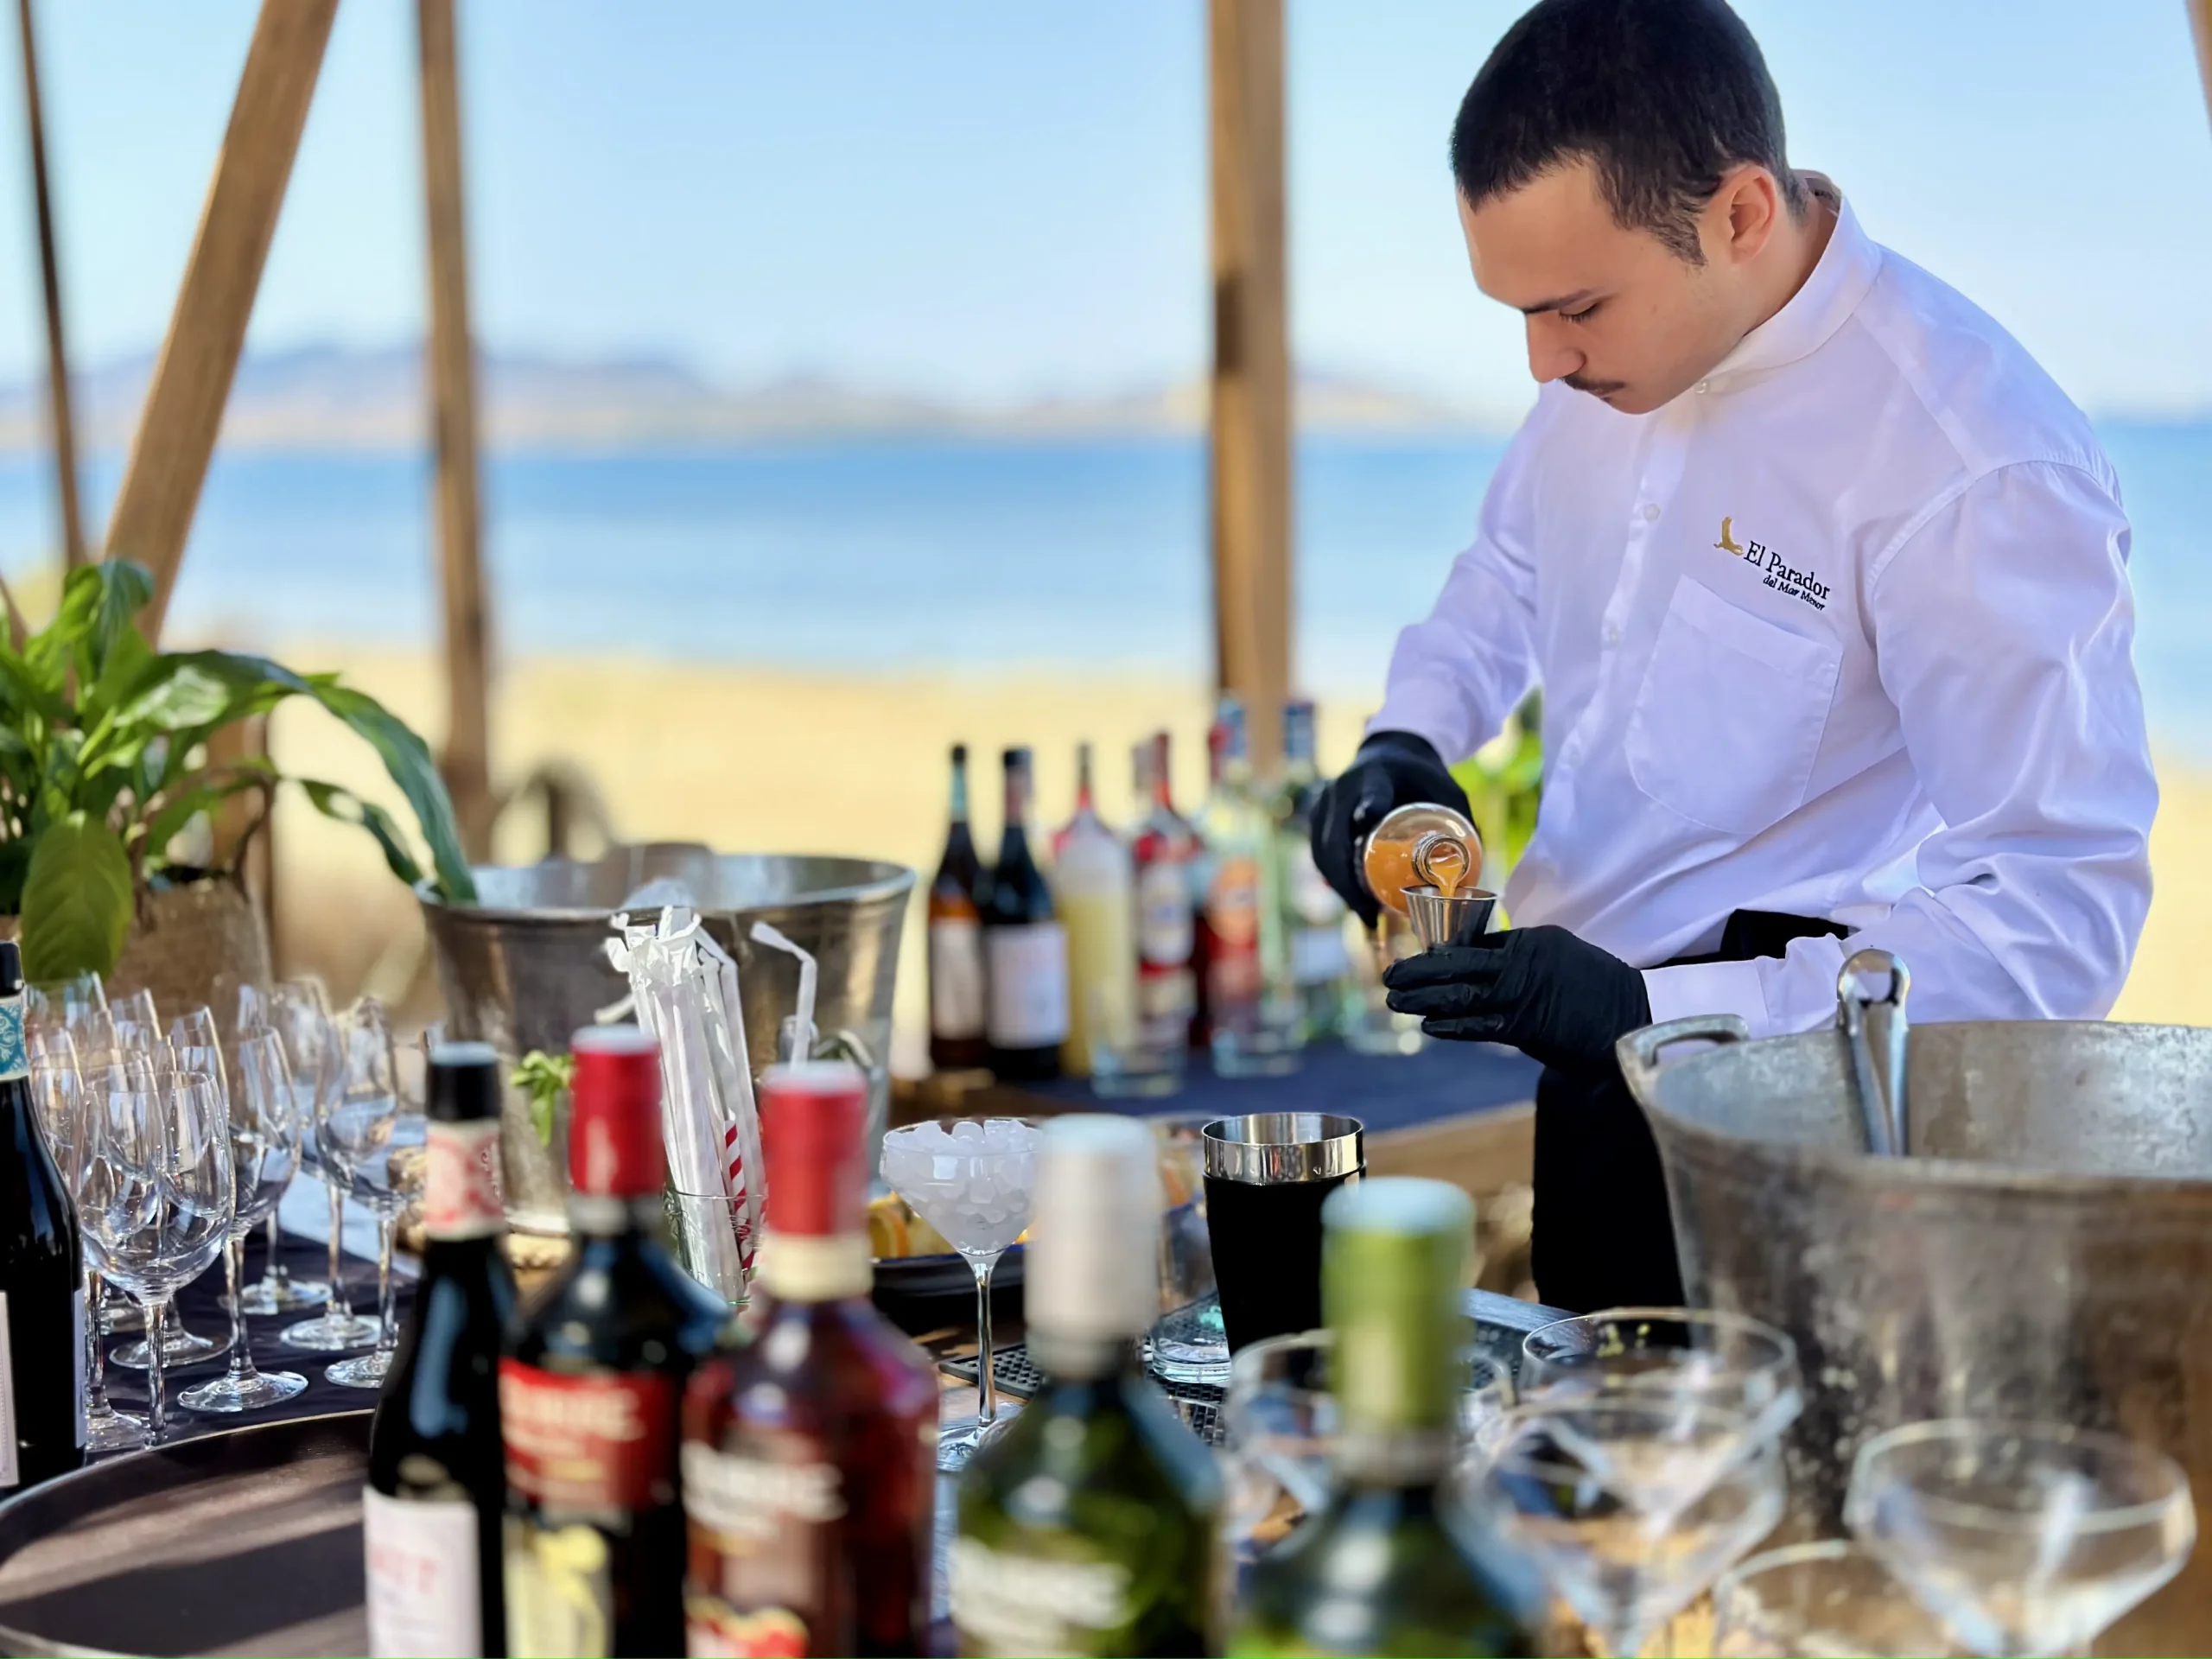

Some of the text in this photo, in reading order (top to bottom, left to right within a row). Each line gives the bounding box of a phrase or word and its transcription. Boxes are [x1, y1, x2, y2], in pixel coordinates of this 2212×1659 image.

[1743, 540, 1831, 601] El Parador
[1763, 575, 1826, 611] del Mar Menor
